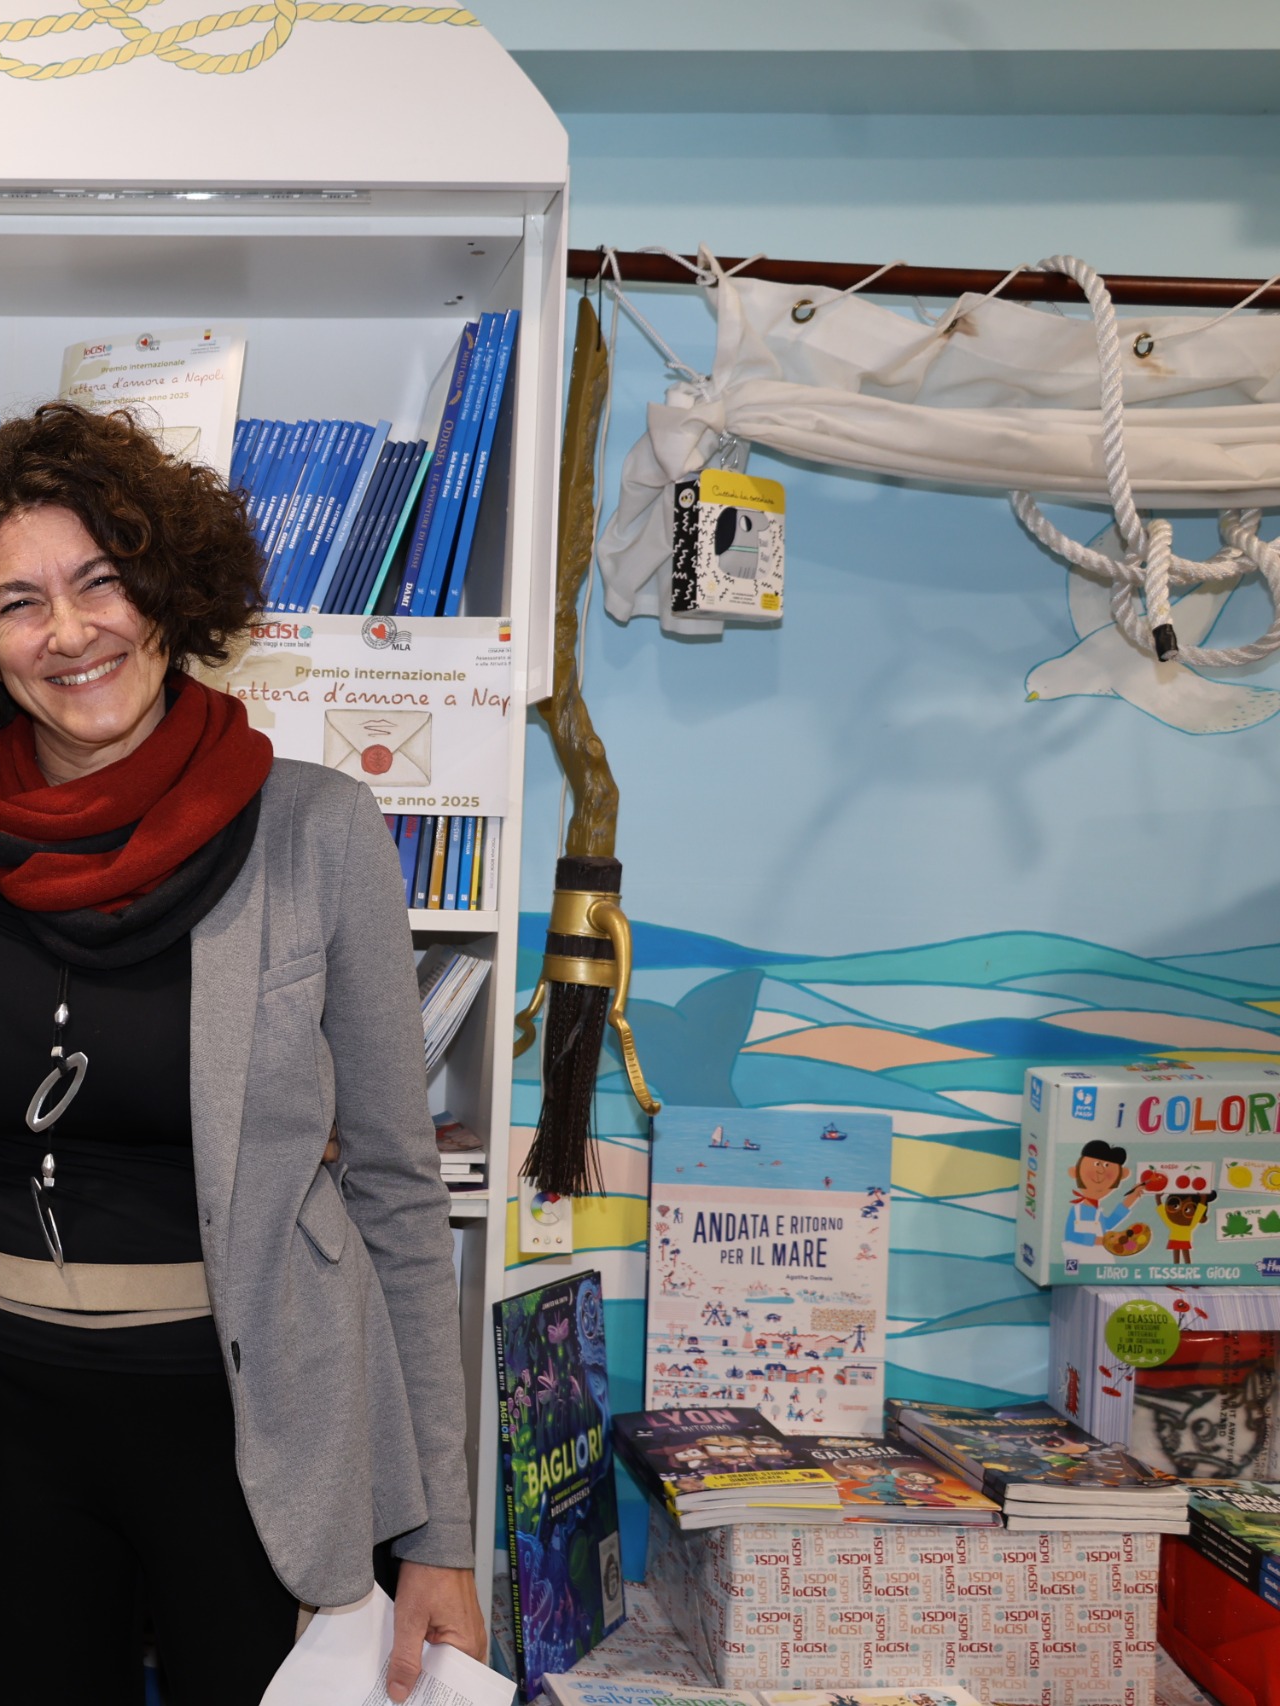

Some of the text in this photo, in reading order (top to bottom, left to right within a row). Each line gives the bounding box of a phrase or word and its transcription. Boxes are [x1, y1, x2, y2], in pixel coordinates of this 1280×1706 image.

[101, 358, 186, 374] Premio internazionale
[171, 376, 179, 385] a
[169, 392, 189, 400] 2025
[434, 420, 454, 466] ODISSEA
[422, 483, 438, 529] AVVENTURE
[401, 582, 414, 608] DAMI
[391, 643, 411, 651] MLA
[295, 665, 466, 682] Premio internazionale
[324, 682, 430, 706] d'amore
[443, 693, 457, 706] a
[397, 796, 437, 807] anno
[441, 795, 480, 808] 2025
[693, 1211, 844, 1244] ANDATA E RITORNO
[720, 1238, 827, 1268] PER IL MARE
[1096, 1266, 1128, 1279] LIBRO
[1134, 1267, 1142, 1279] E
[1148, 1266, 1201, 1280] TESSERE
[1206, 1266, 1241, 1279] GIOCO
[1127, 1314, 1168, 1324] CLASSICO
[1117, 1344, 1143, 1354] PLAID
[499, 1400, 511, 1443] BAGLIORI
[644, 1409, 740, 1428] LYON
[528, 1424, 604, 1497] BAGLIORI
[811, 1446, 901, 1461] GALASSIA
[599, 1683, 619, 1693] sei
